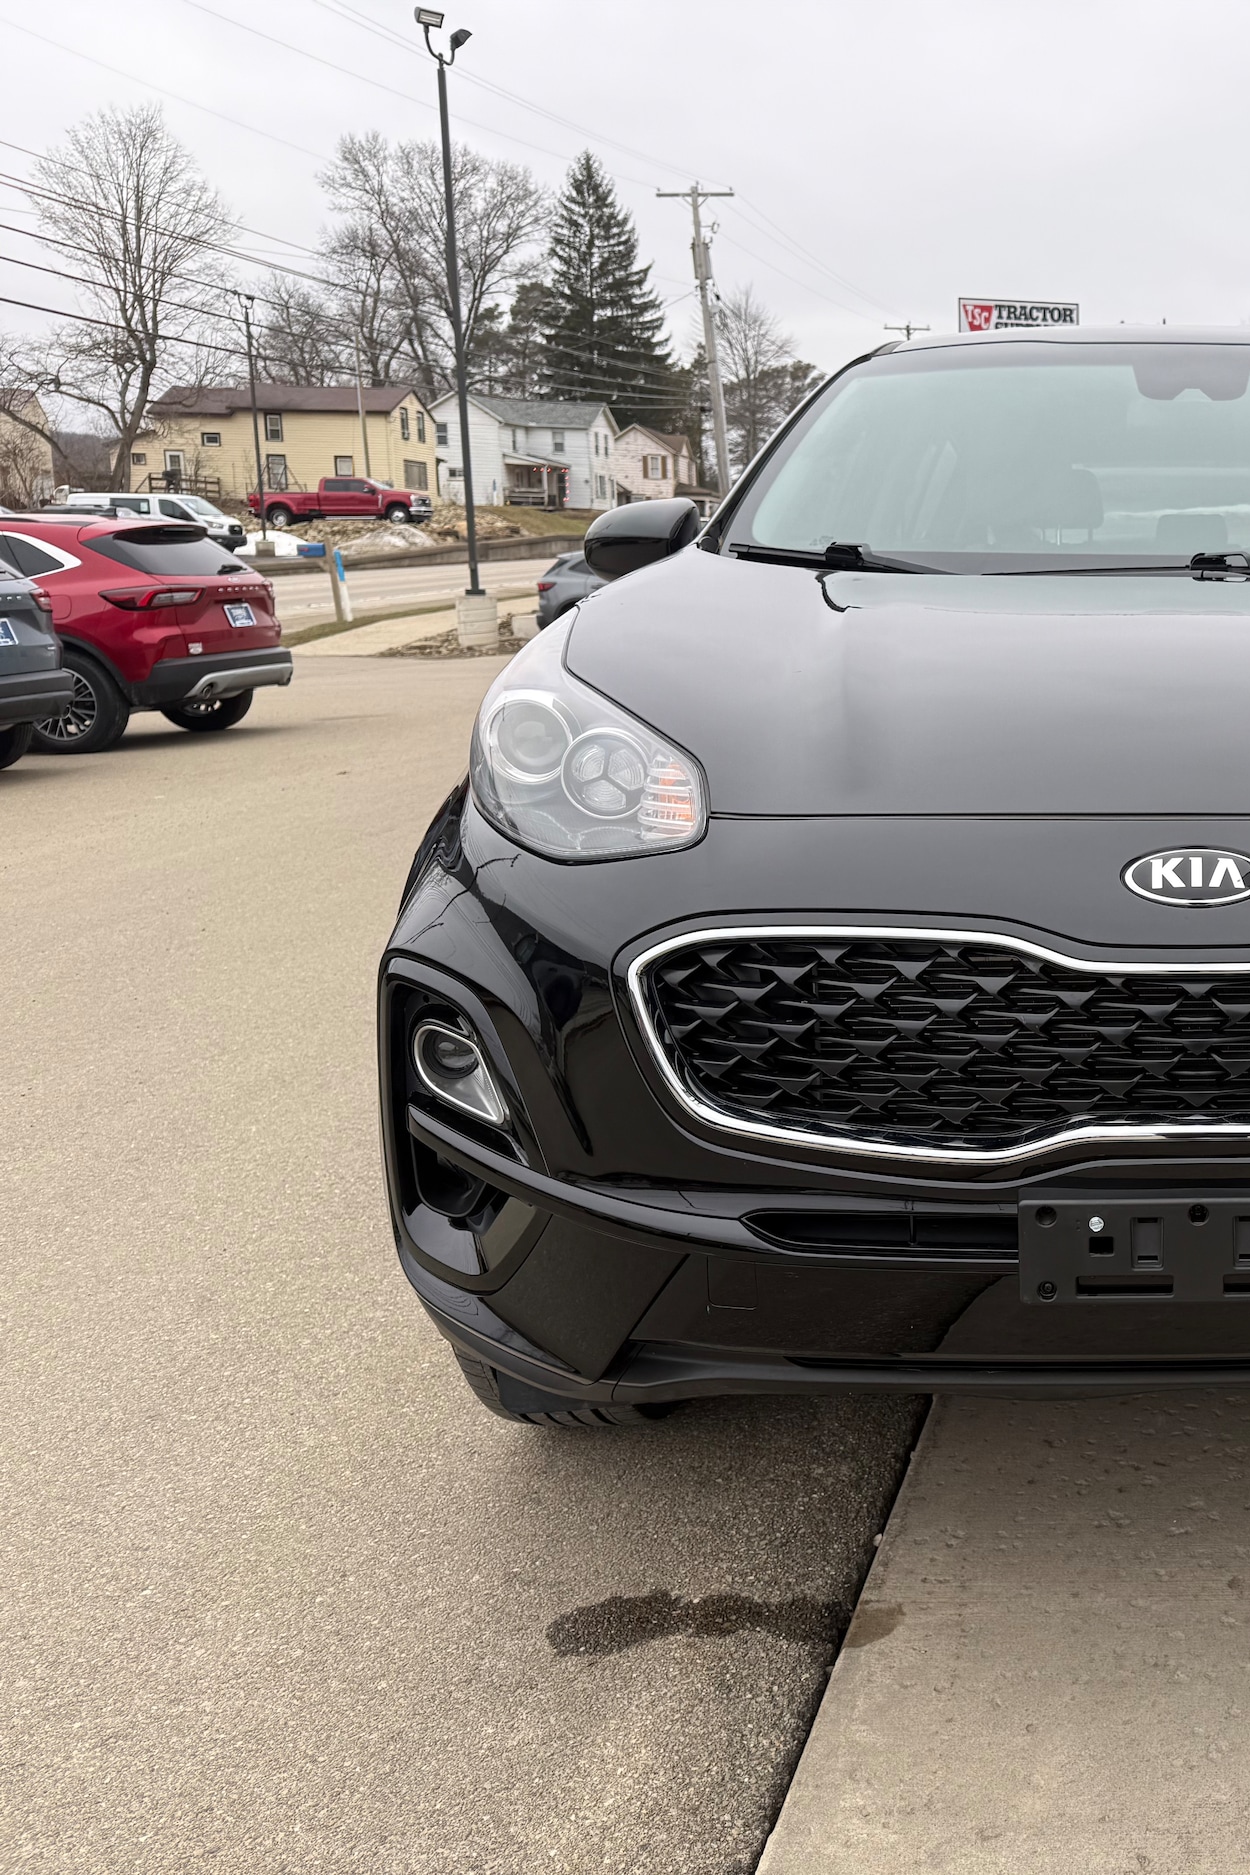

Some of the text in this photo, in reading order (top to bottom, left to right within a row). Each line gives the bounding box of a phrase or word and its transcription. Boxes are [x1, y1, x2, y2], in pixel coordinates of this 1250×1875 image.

[965, 304, 1074, 329] TSC TRACTOR
[1150, 857, 1246, 889] KIA
